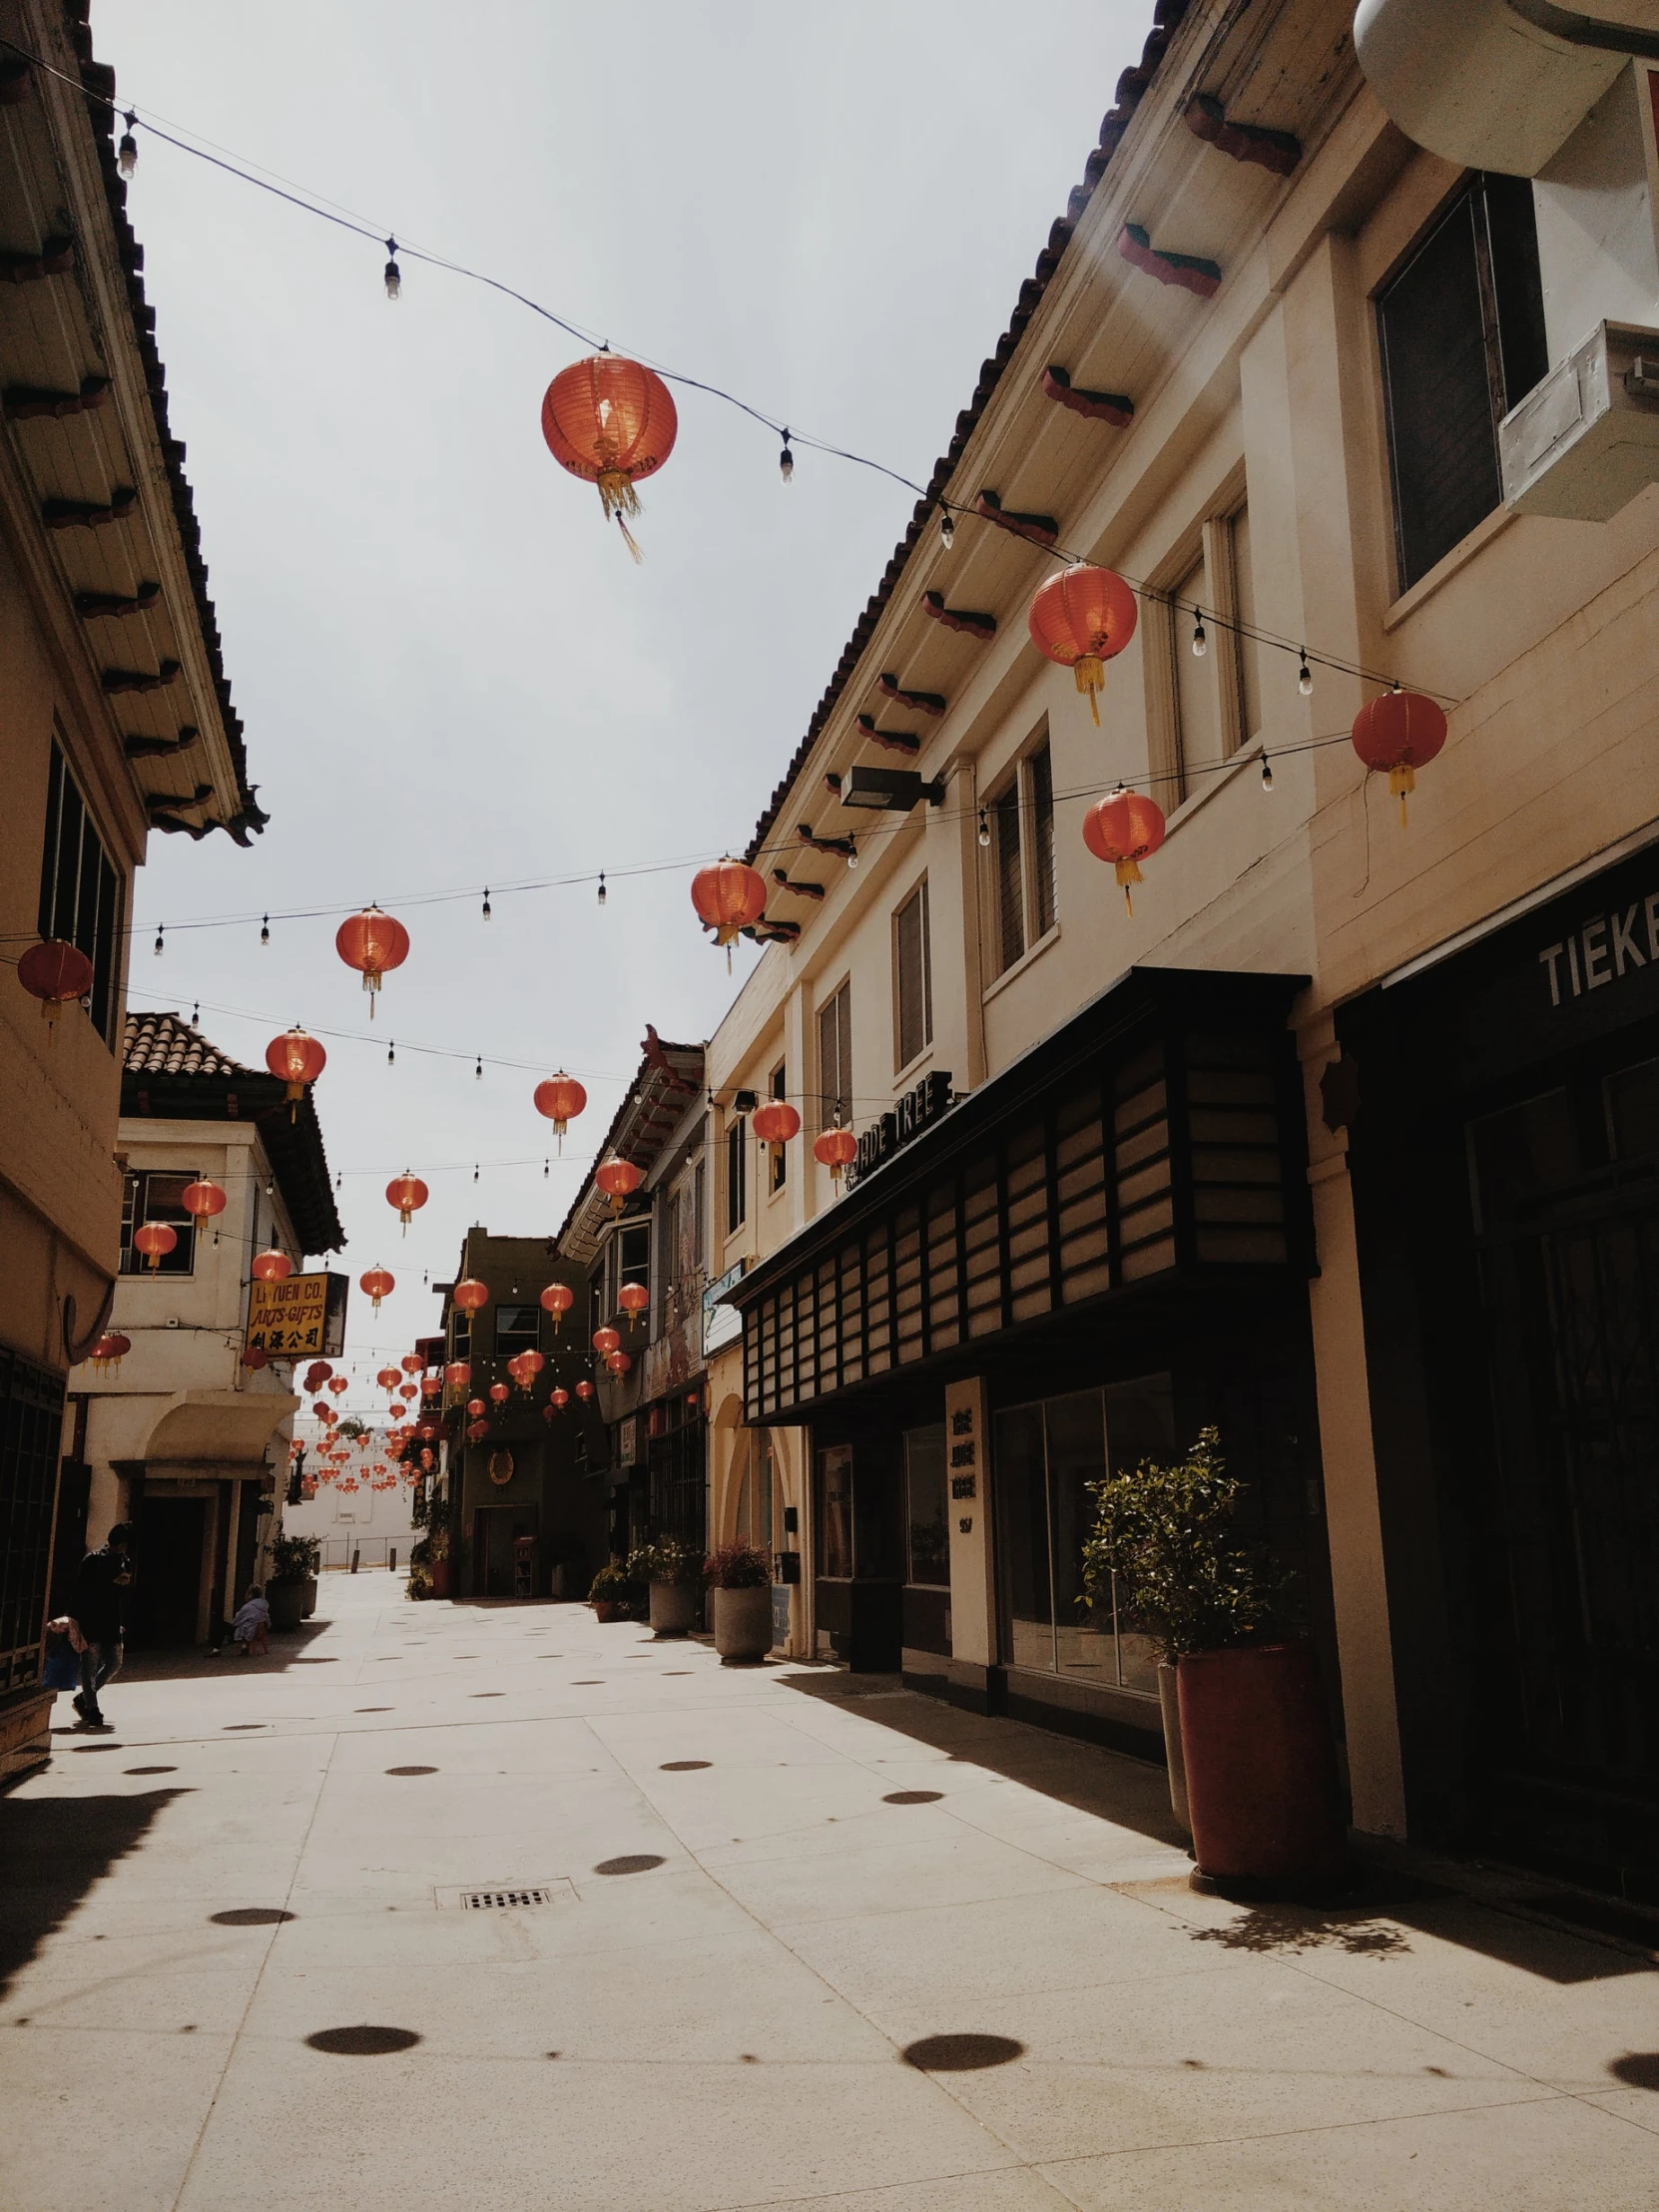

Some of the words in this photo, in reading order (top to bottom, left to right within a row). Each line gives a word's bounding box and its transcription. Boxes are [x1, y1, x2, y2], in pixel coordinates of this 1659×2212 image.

[893, 1071, 940, 1143] TREE
[304, 1282, 322, 1300] CO.
[951, 1408, 973, 1435] THE
[950, 1439, 976, 1468] JADE
[950, 1474, 977, 1500] TREE
